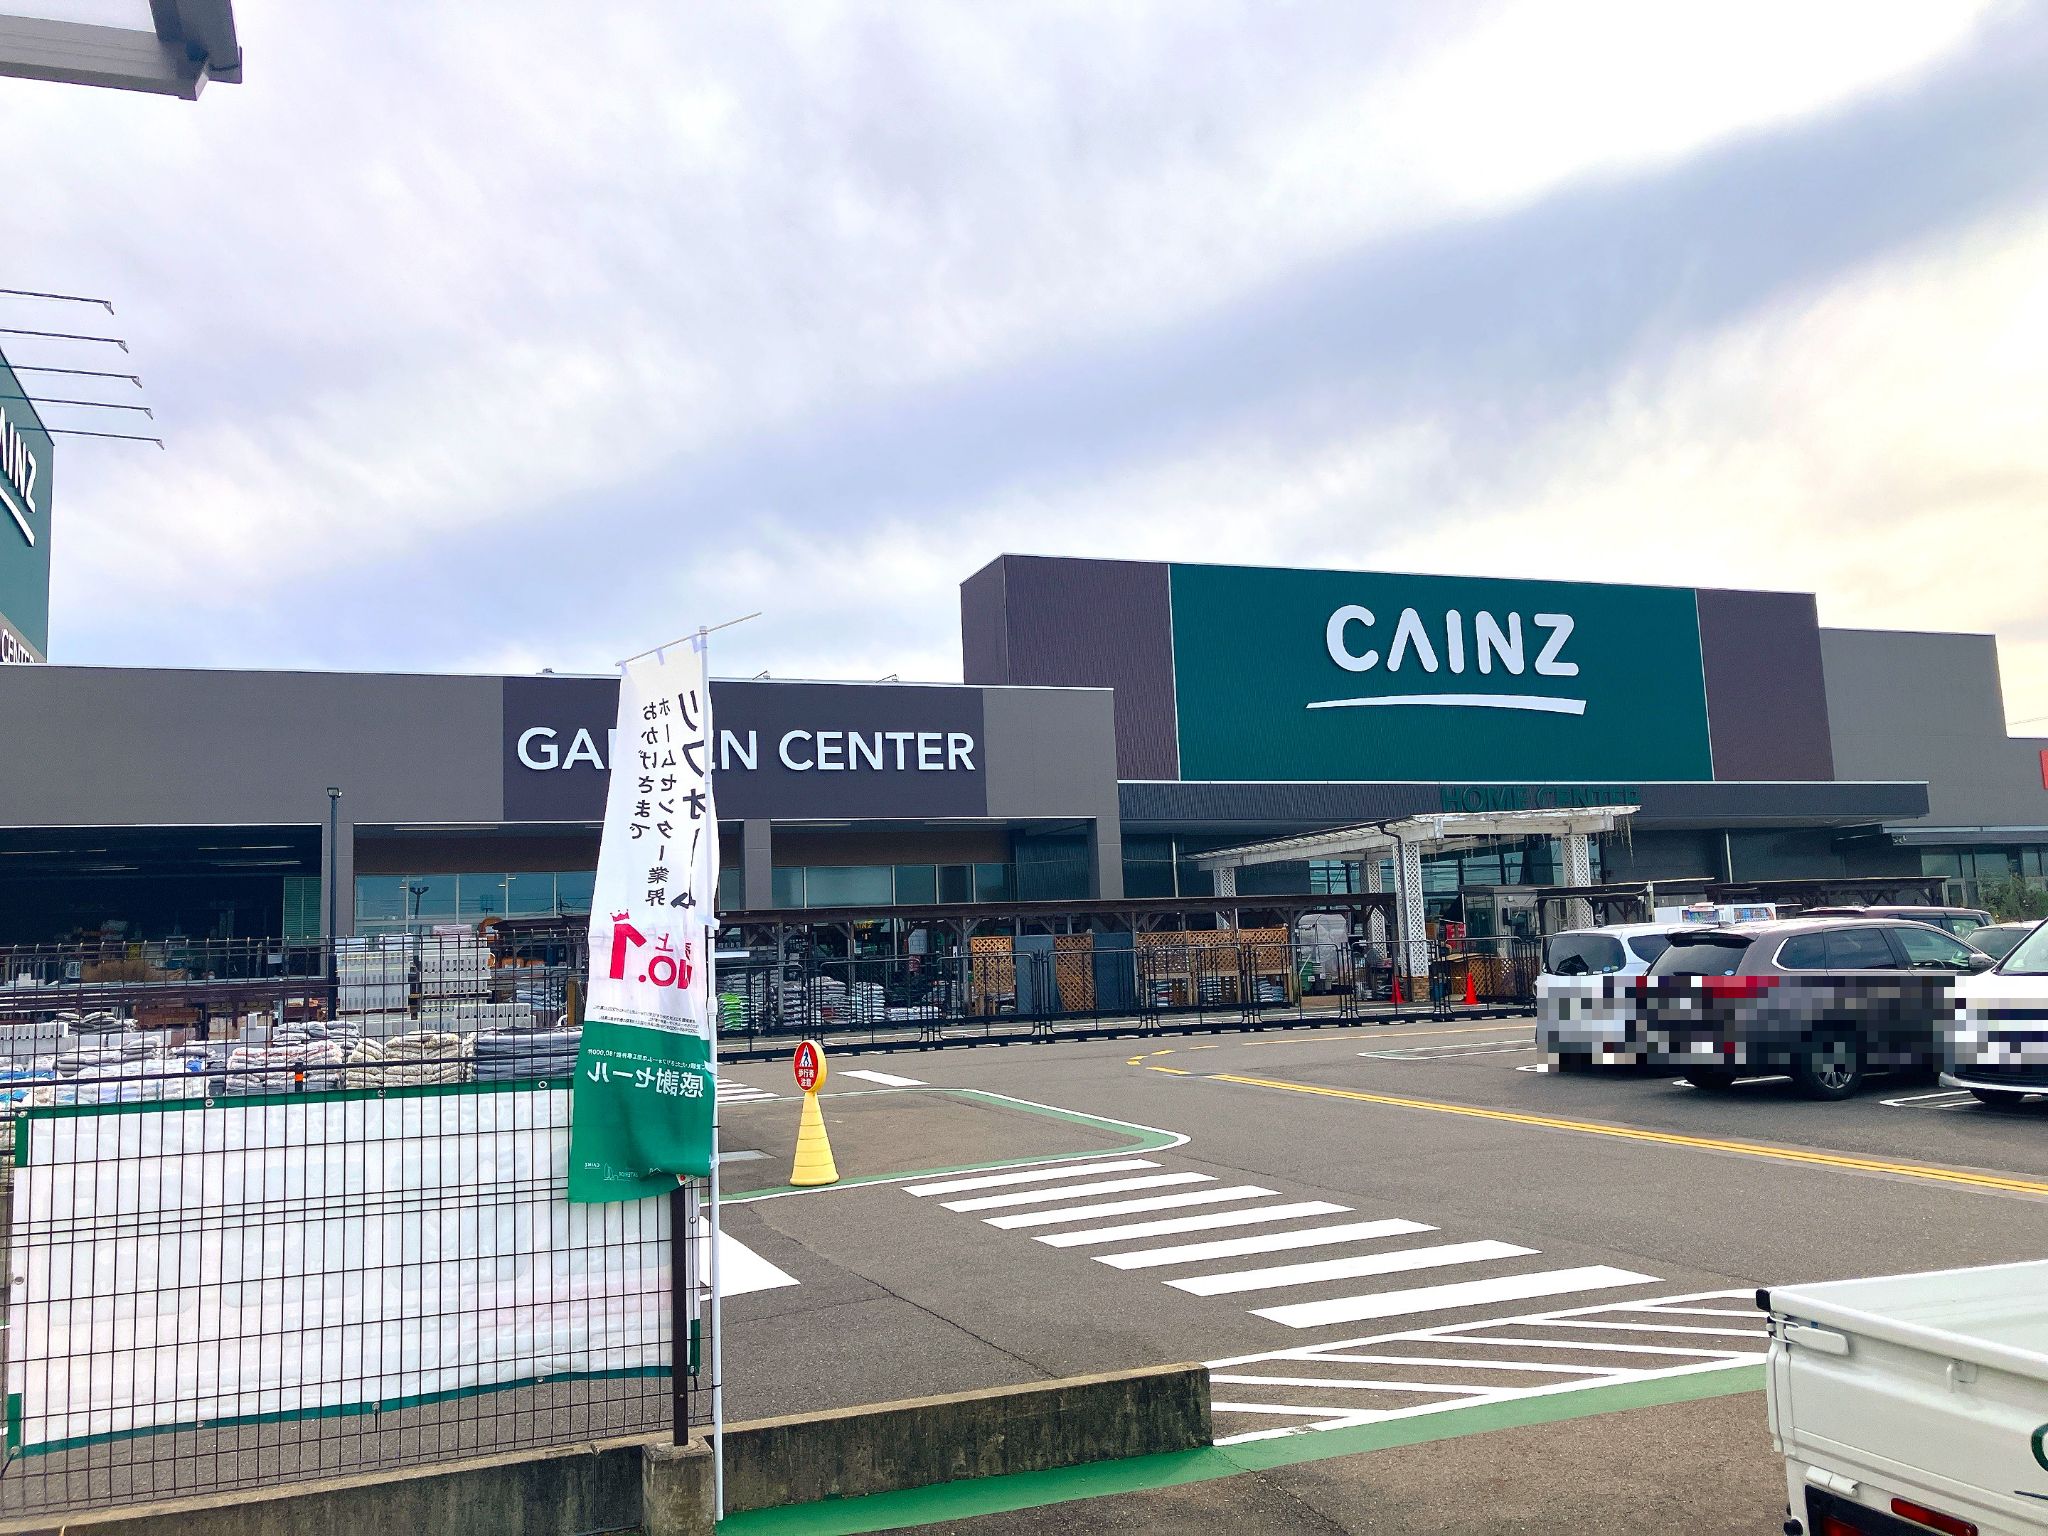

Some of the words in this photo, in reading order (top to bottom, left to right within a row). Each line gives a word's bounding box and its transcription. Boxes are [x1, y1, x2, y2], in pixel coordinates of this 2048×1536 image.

[1326, 604, 1579, 676] CAINZ
[516, 727, 758, 771] GAN
[778, 729, 976, 772] CENTER
[1440, 786, 1529, 812] HOME
[1537, 786, 1641, 808] CENTER
